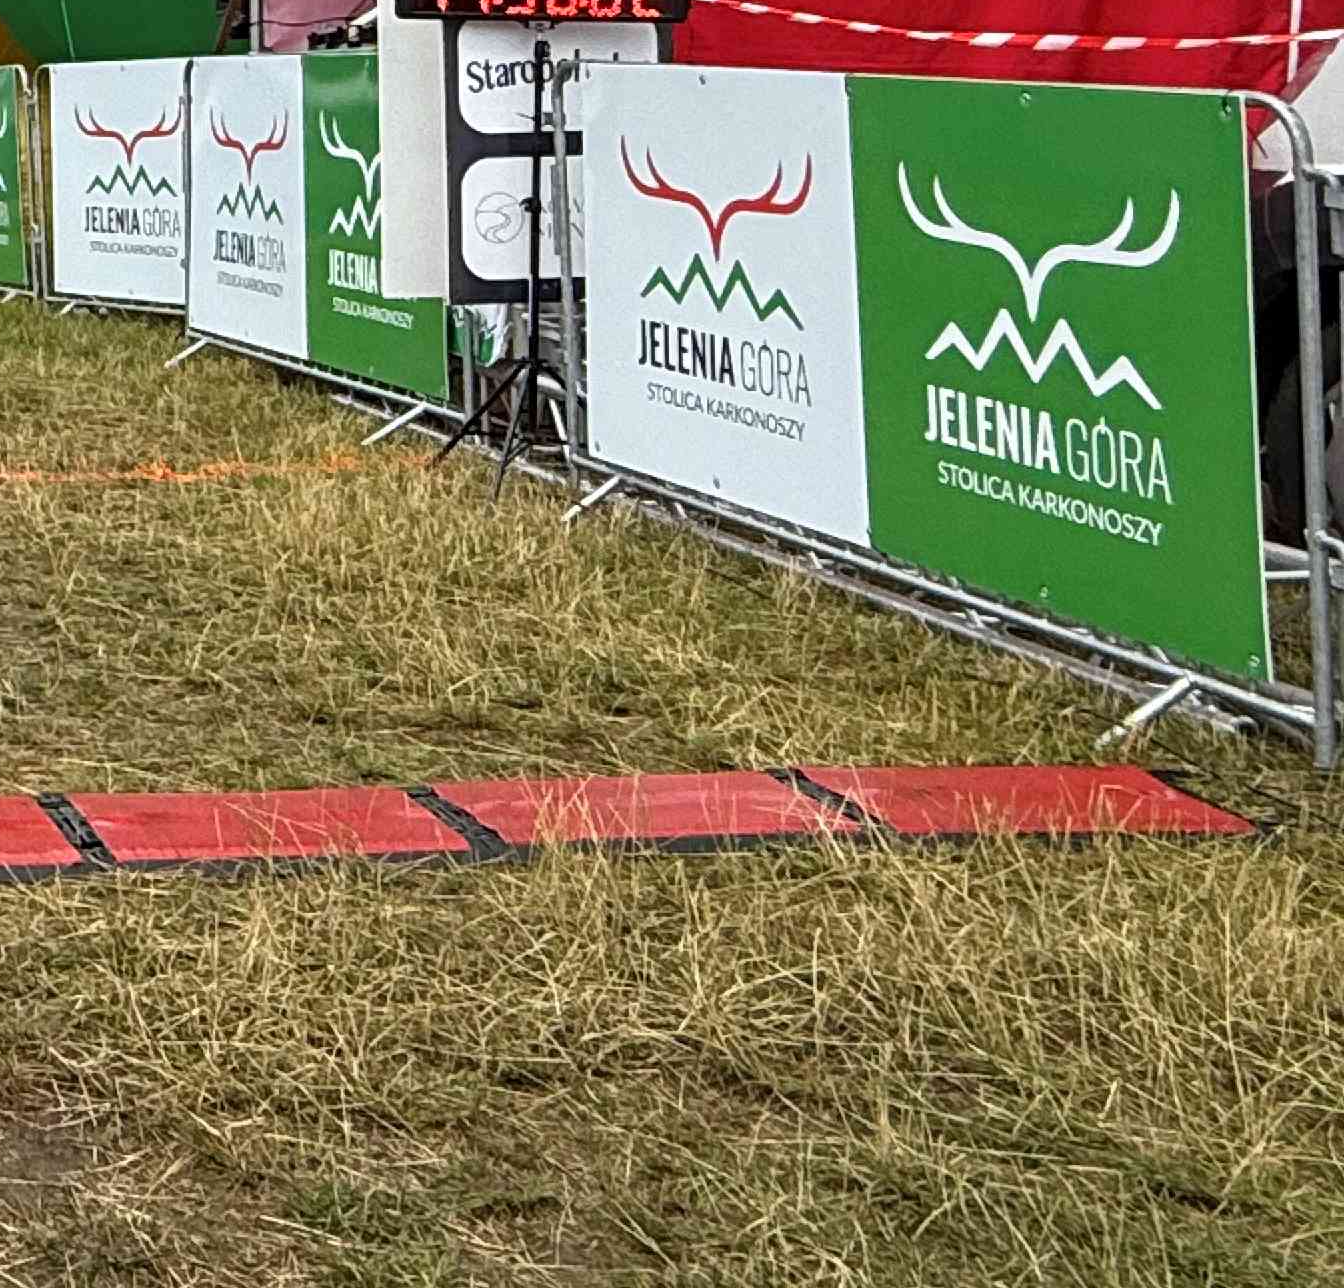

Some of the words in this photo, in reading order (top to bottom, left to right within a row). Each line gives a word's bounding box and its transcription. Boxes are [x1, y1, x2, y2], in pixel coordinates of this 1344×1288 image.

[85, 206, 140, 235] JELENIA
[142, 205, 181, 238] GÓRA
[213, 229, 255, 267] JELENIA
[328, 249, 379, 295] JELENIA
[638, 318, 737, 387] JELENIA
[738, 338, 812, 407] GÓRA
[647, 382, 704, 412] STOLICA
[706, 397, 807, 441] KARKONOSZY
[924, 383, 1059, 473] JELENIA
[1064, 416, 1173, 505] GÓRA
[937, 461, 1015, 505] STOLICA
[1017, 484, 1164, 547] KARKONOSZY
